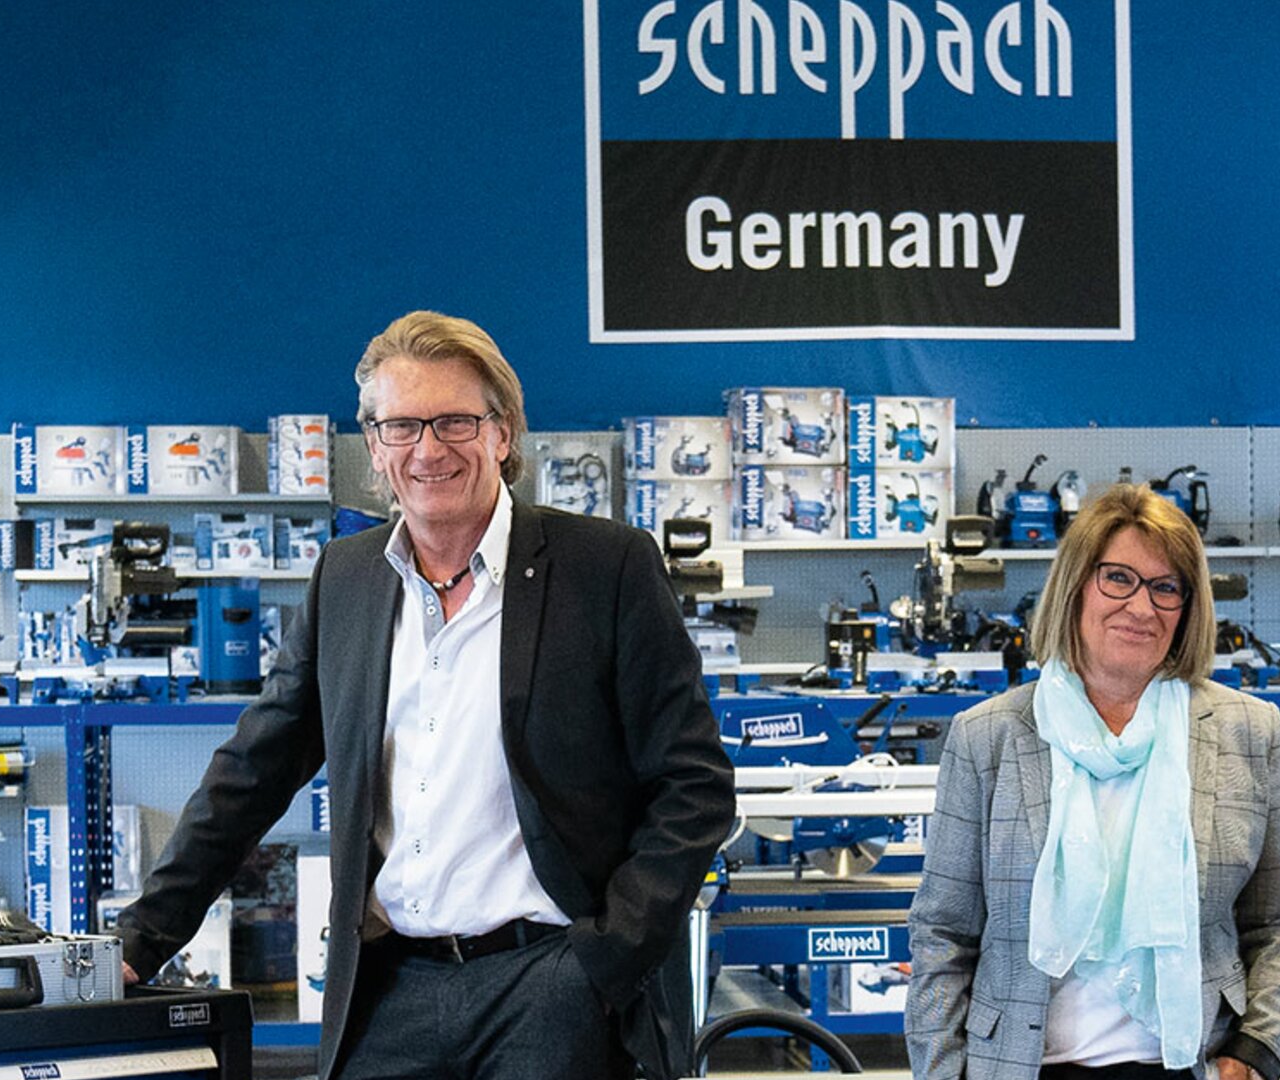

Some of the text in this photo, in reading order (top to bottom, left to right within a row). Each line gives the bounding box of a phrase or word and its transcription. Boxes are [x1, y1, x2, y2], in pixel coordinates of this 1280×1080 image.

[637, 0, 1073, 140] scheppach
[685, 195, 1025, 288] Germany
[742, 391, 764, 445] scheppach
[849, 402, 876, 463] scheppach
[16, 435, 37, 487] scheppach
[125, 433, 149, 486] scheppach
[742, 468, 764, 520] scheppach
[849, 474, 876, 535] scheppach
[747, 715, 797, 738] scheppach
[28, 817, 51, 867] scheppach
[815, 930, 882, 956] scheppach
